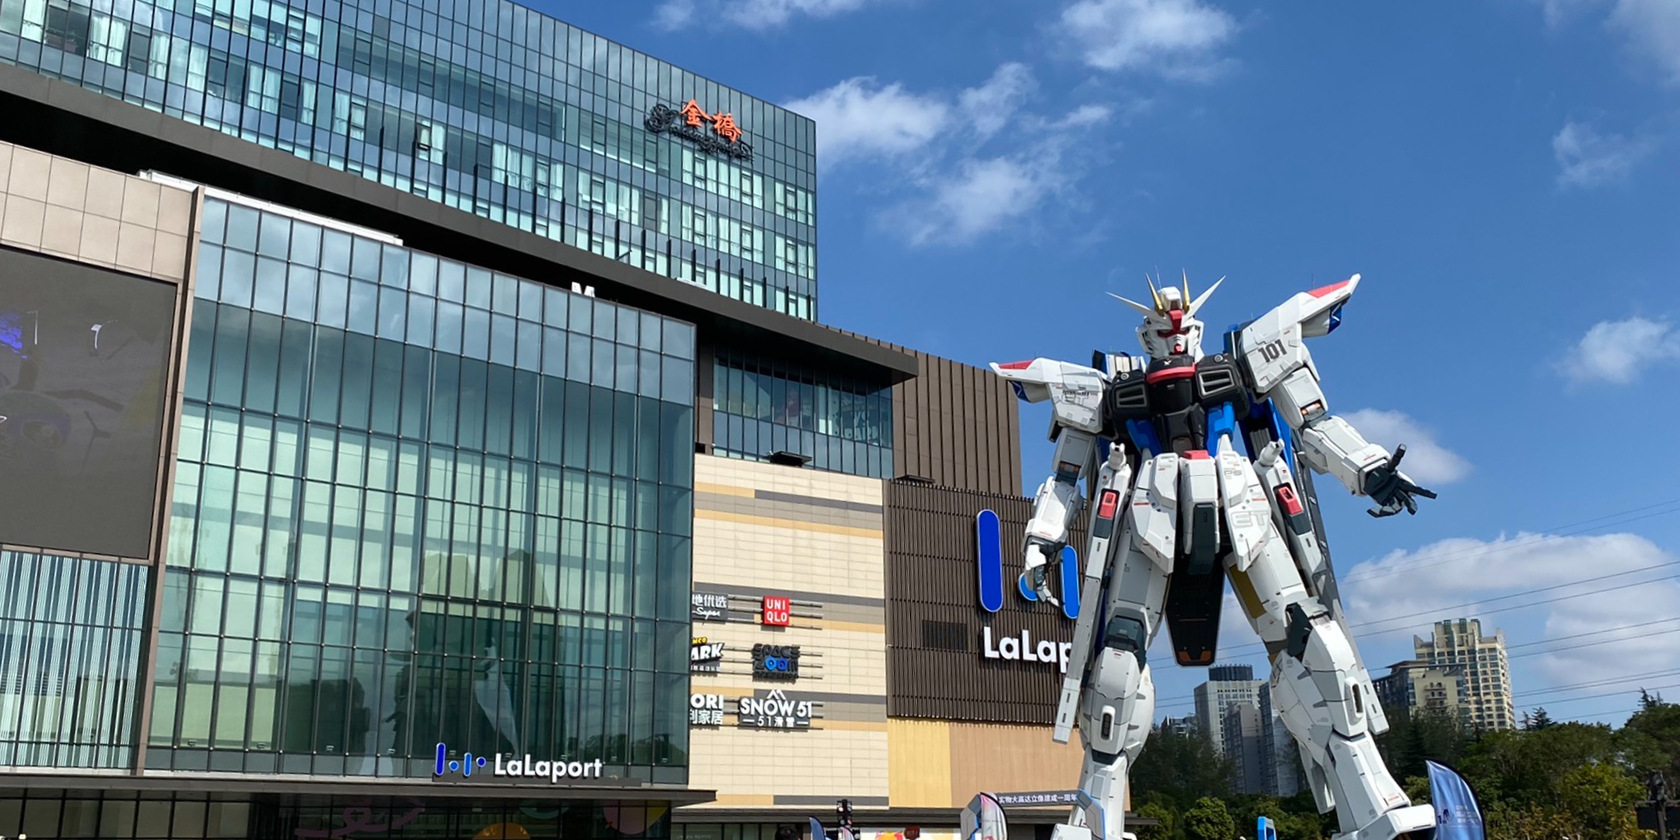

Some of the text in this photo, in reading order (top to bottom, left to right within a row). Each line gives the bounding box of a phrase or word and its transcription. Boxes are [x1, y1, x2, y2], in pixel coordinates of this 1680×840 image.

[1258, 339, 1287, 363] 101
[766, 598, 786, 610] UNI
[766, 611, 788, 623] QLO
[691, 643, 723, 660] ARK
[690, 693, 724, 709] ORI
[740, 698, 812, 718] SNOW 51
[494, 753, 602, 783] LaLaport
